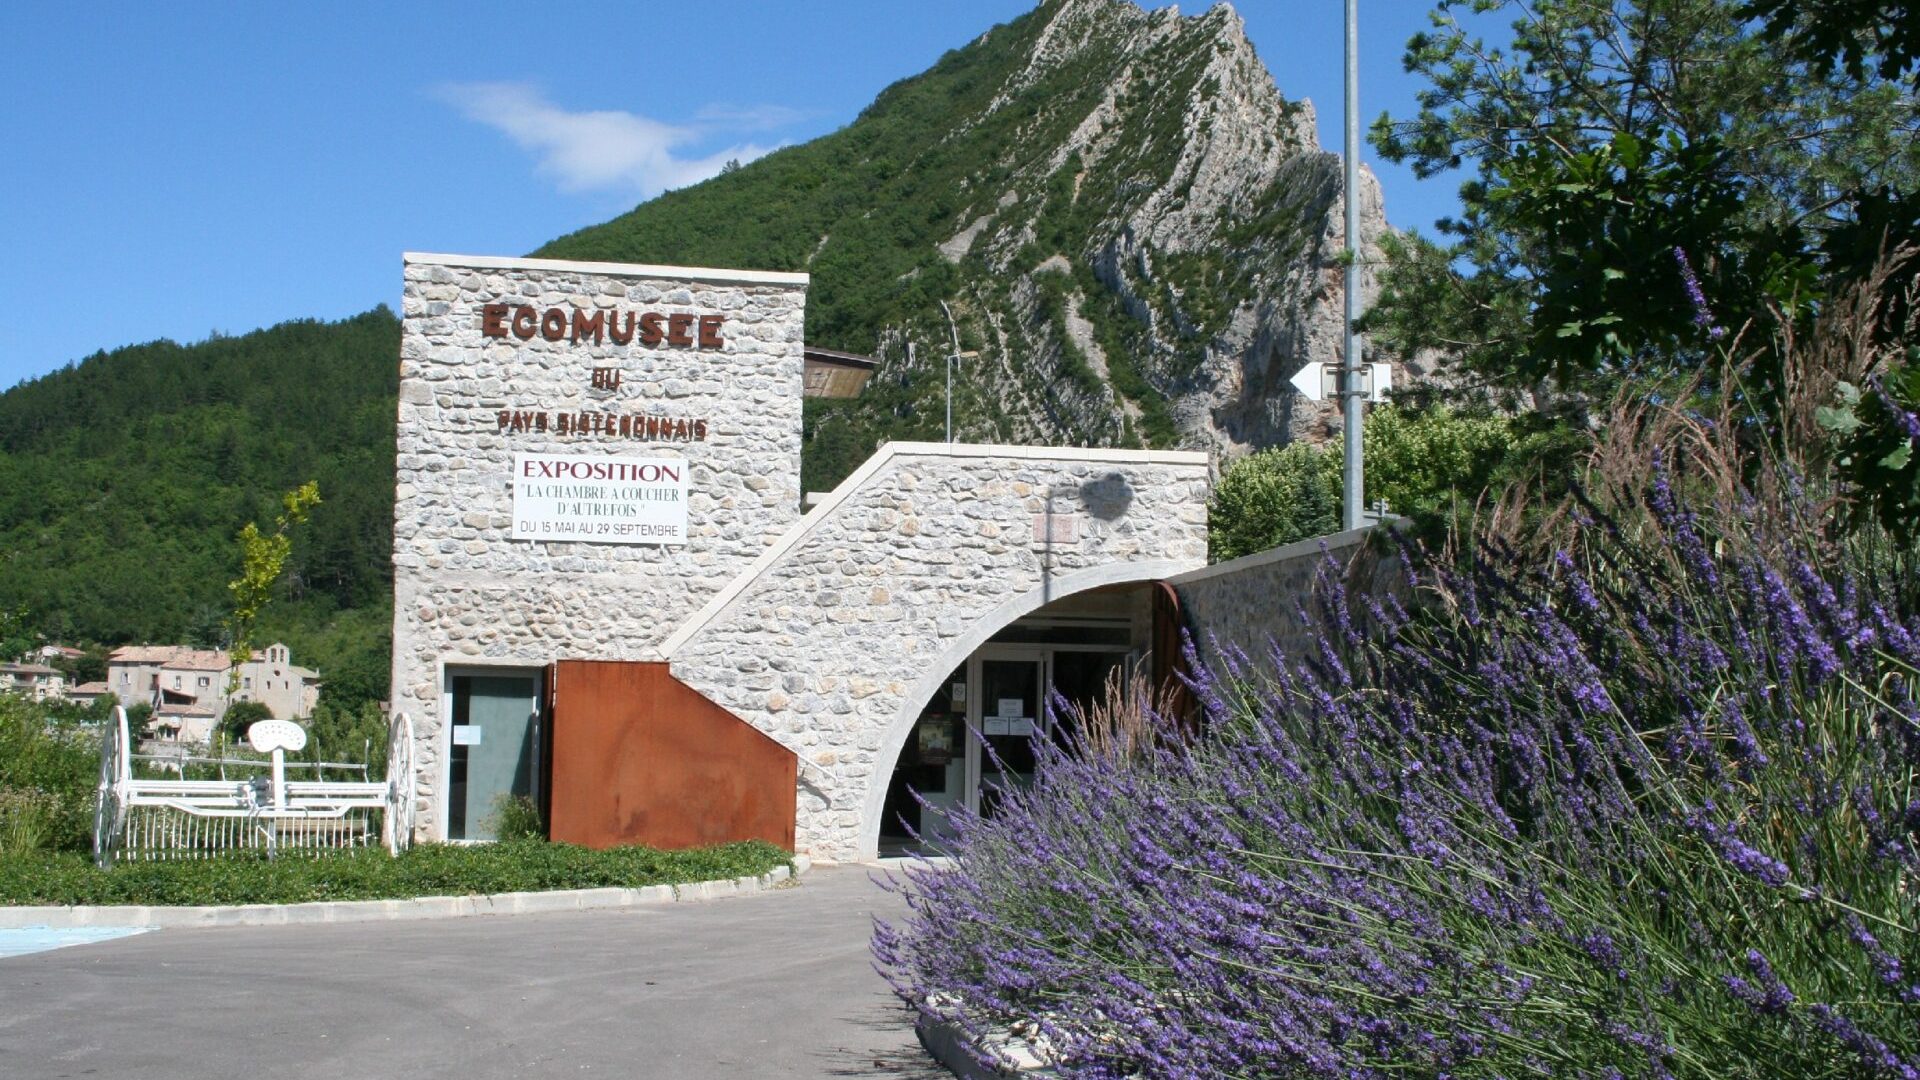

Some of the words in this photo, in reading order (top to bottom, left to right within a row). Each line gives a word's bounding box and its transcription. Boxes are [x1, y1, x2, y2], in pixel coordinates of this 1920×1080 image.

[482, 304, 724, 348] ECOMUSEE
[592, 367, 620, 390] DU
[498, 410, 548, 433] PAYS
[557, 412, 708, 441] SISTERONNAIS
[523, 460, 680, 482] EXPOSITION
[546, 485, 608, 500] CHAMBRE
[622, 487, 679, 501] COUCHER
[520, 520, 537, 532] DU
[541, 521, 551, 533] 15
[555, 522, 575, 533] MAI
[578, 523, 594, 534] AU
[597, 523, 610, 534] 29
[613, 524, 679, 537] SEPTEMBRE
